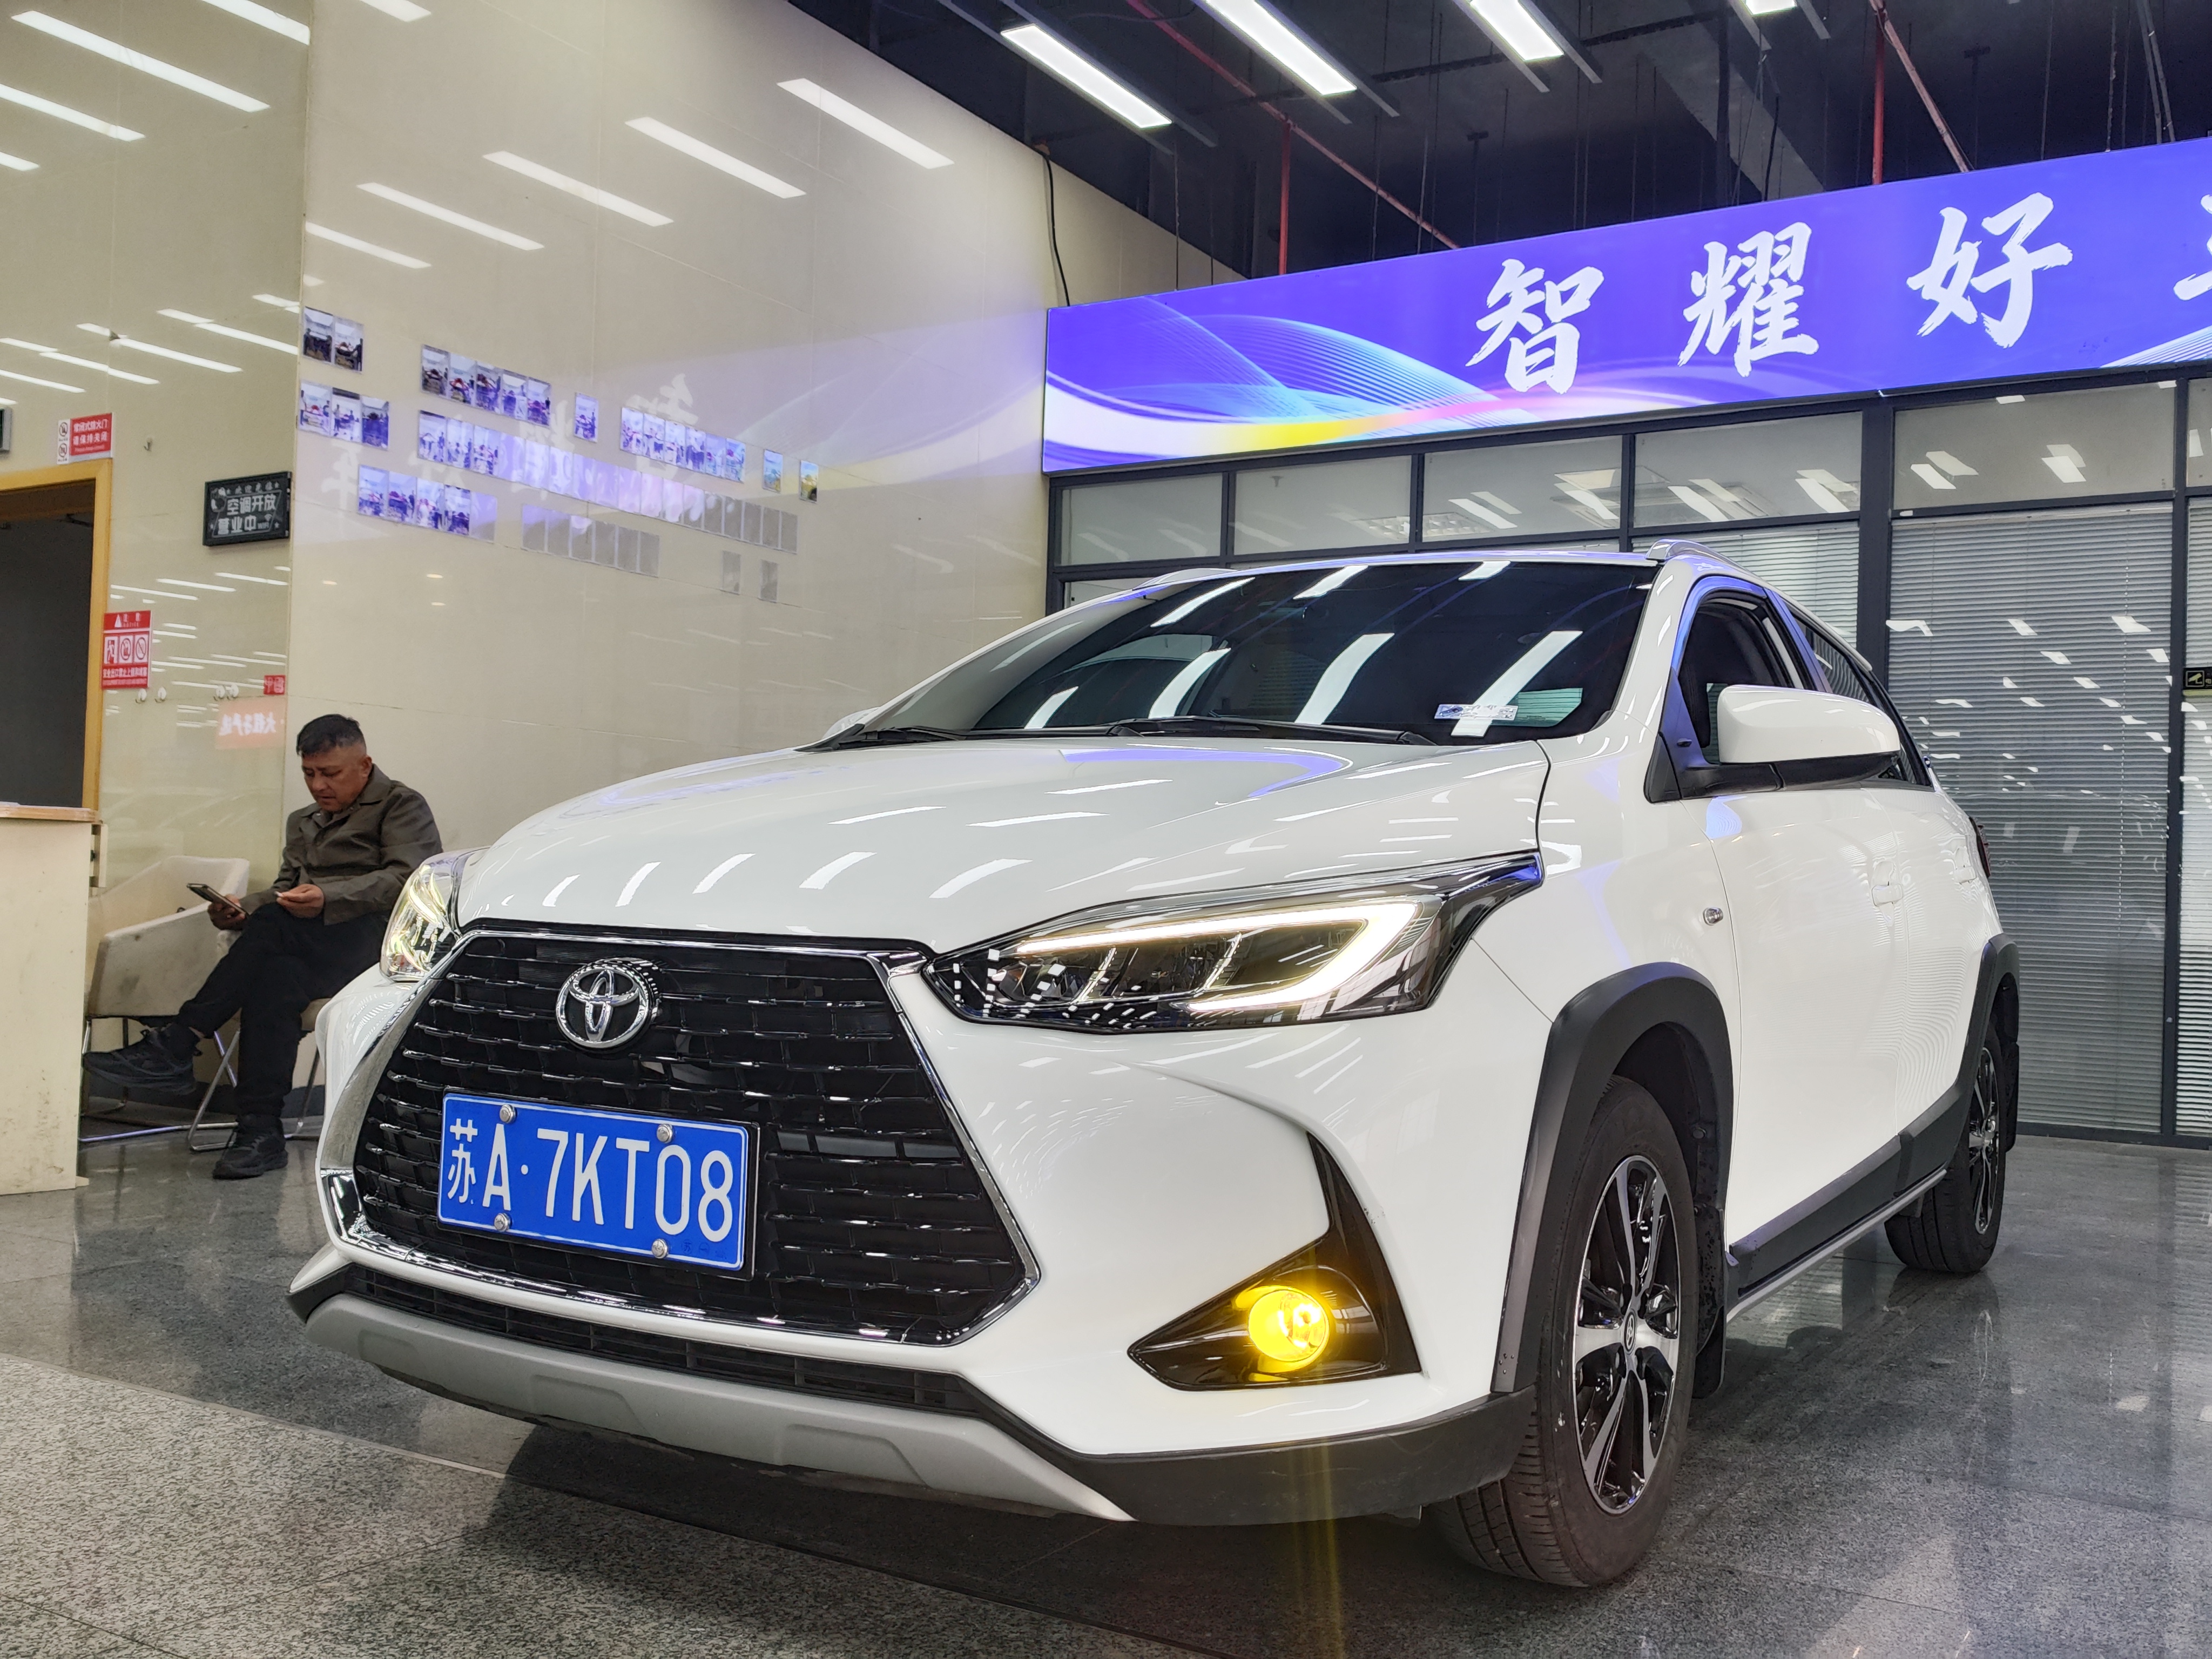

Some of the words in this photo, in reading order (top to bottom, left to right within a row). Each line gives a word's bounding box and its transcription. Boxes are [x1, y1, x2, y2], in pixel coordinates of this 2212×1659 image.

[227, 494, 276, 516] 空调开放
[218, 515, 257, 535] 营业中
[448, 1118, 733, 1242] 苏A·7KT08
